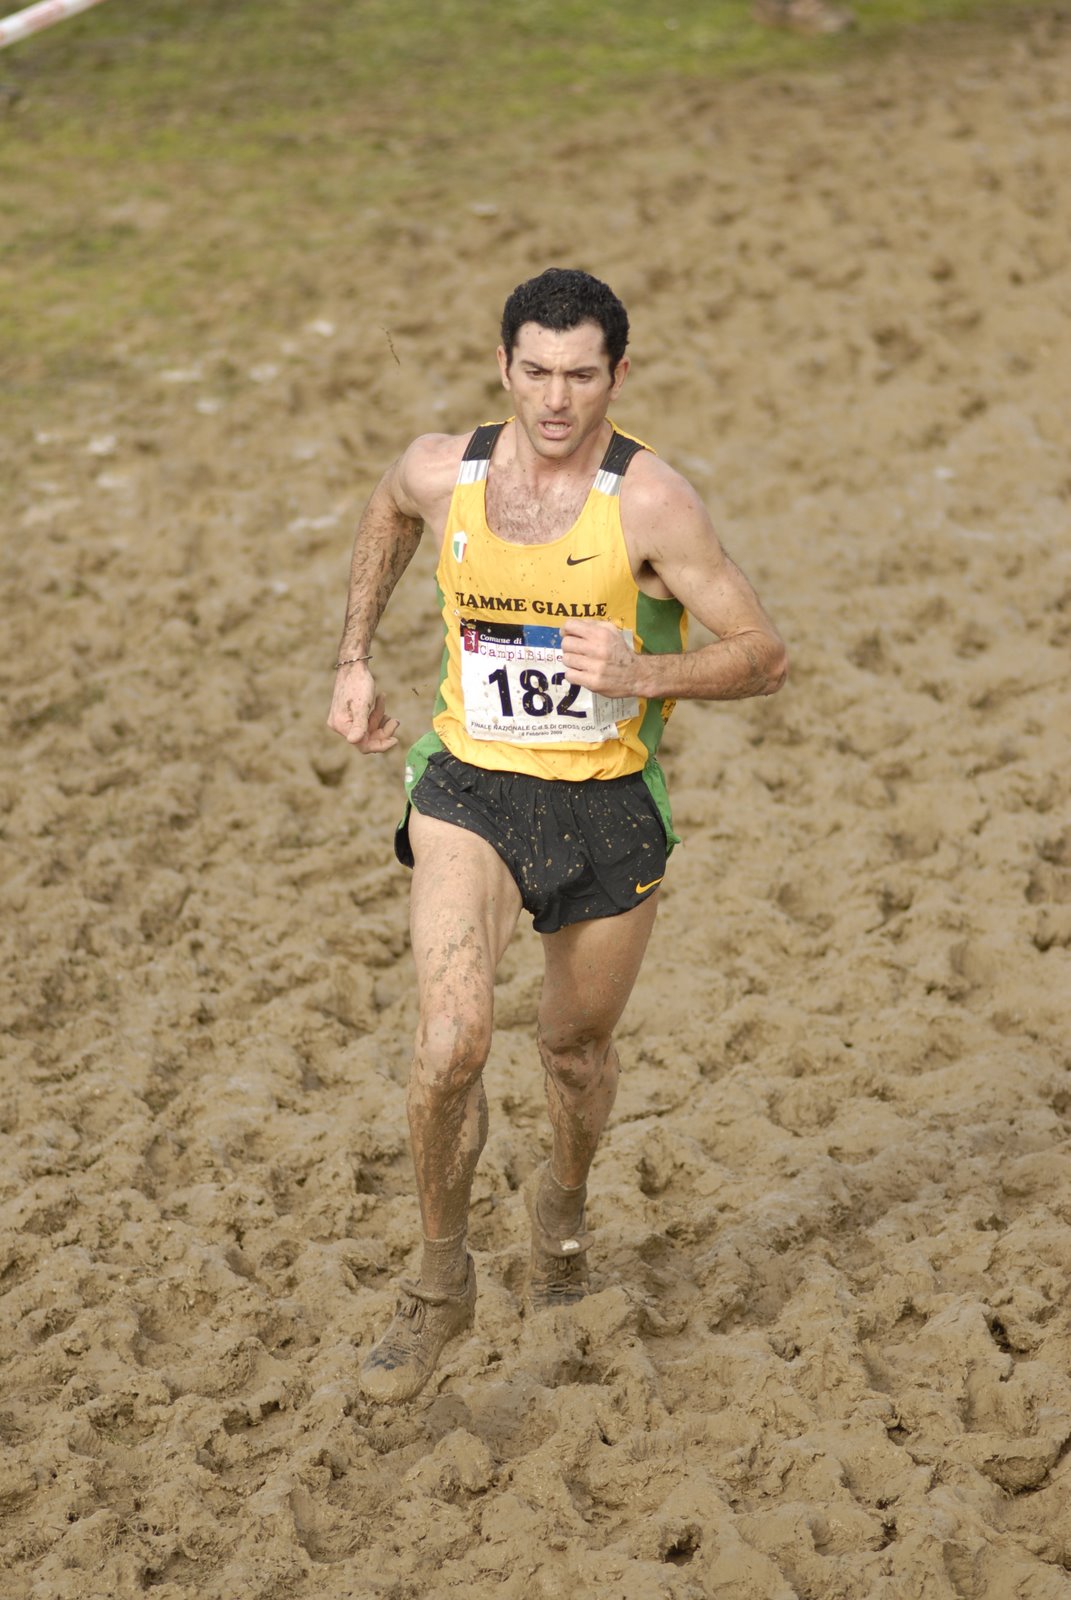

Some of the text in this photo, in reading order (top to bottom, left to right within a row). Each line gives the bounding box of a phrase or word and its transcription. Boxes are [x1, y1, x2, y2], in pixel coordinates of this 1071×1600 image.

[531, 601, 608, 618] GIALLE
[480, 633, 523, 645] Comune di
[479, 645, 563, 662] CampiBise
[488, 667, 587, 719] 182
[471, 721, 492, 730] FINALE
[493, 724, 530, 732] NAZIONALE
